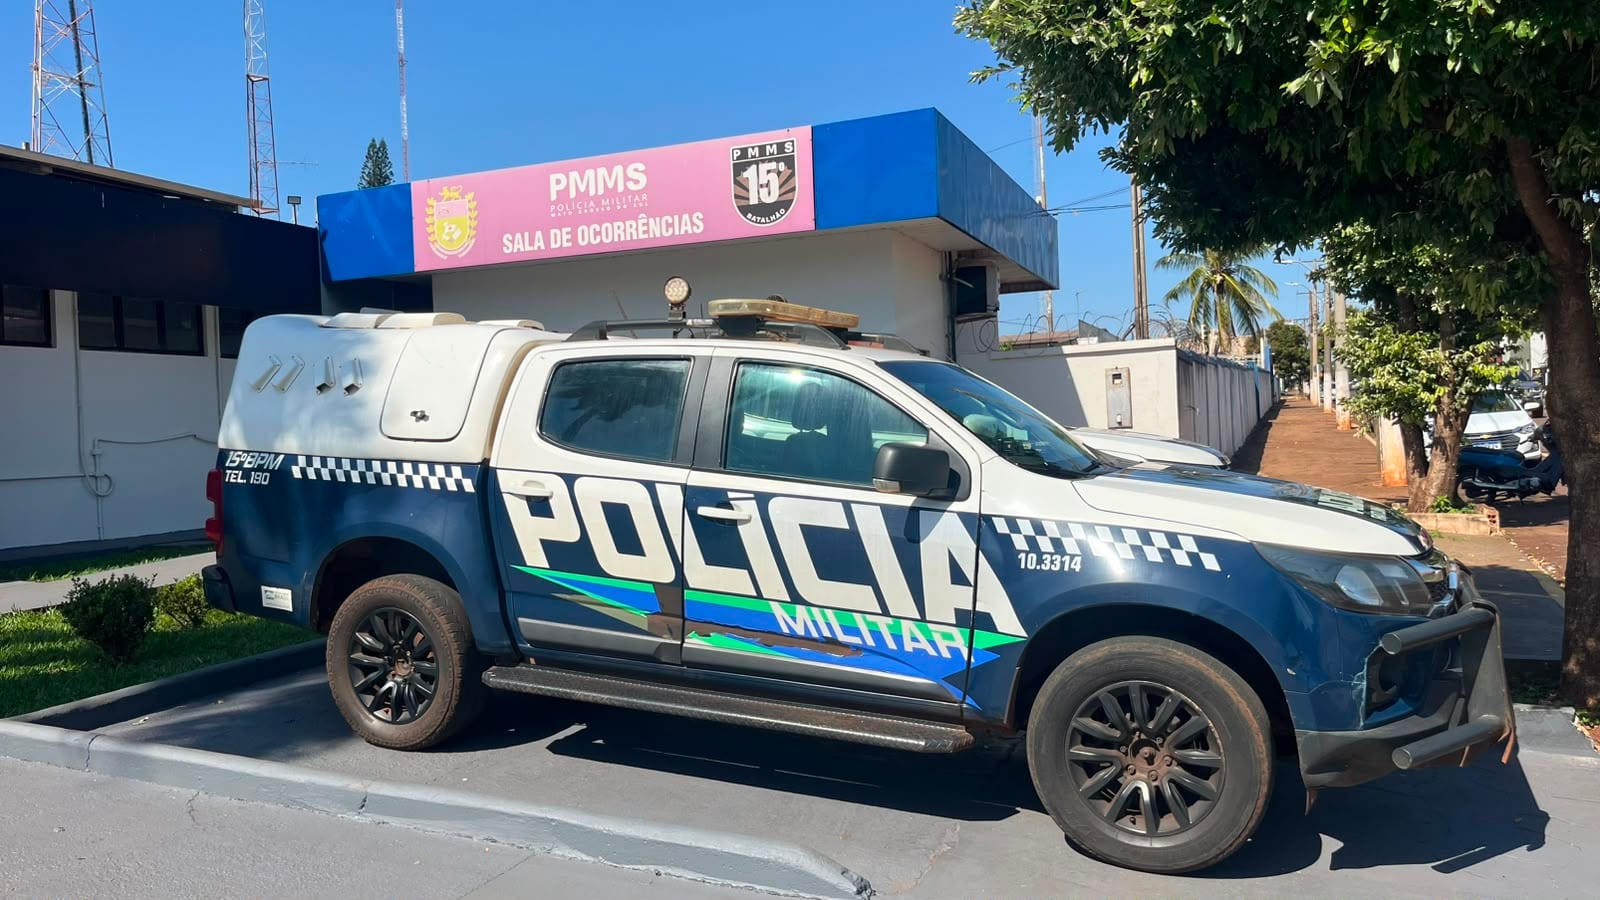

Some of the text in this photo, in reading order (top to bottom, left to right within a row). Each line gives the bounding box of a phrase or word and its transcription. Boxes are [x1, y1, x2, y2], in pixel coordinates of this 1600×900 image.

[733, 141, 793, 161] PMMS
[549, 162, 647, 201] PMMS
[550, 200, 595, 213] POLÍCIA
[601, 193, 648, 206] MILITAR
[746, 208, 786, 223] BATALHÃO
[502, 212, 704, 254] SALA DE OCORRÊNCIAS
[225, 470, 270, 485] TEL. 190
[1017, 552, 1082, 572] 10.3314
[768, 601, 976, 663] MILITAR
